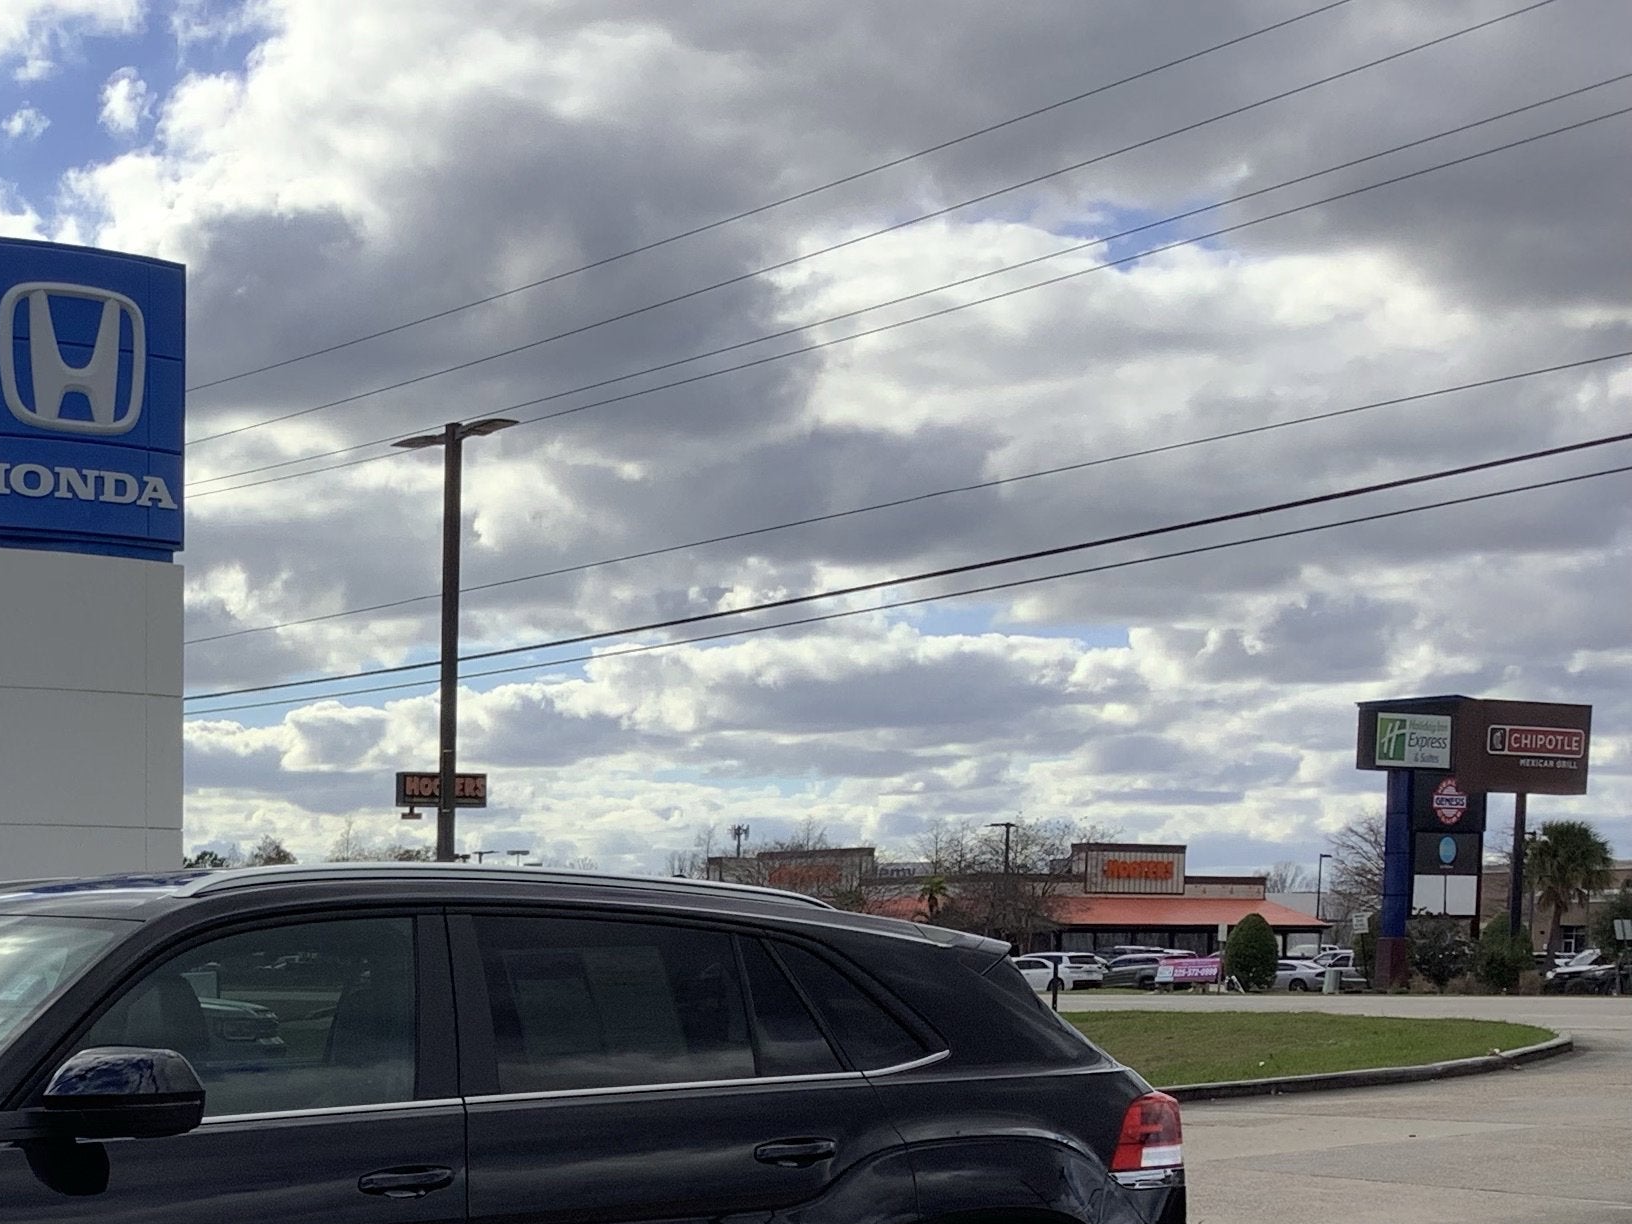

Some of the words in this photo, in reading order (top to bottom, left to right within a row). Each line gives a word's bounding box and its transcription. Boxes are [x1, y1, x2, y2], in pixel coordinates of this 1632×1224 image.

[1409, 732, 1447, 751] Express
[1511, 733, 1580, 751] CHIPOTLE
[1520, 759, 1554, 768] MEXICAN
[1556, 760, 1577, 769] GRILL
[405, 776, 485, 797] HOERS
[1435, 797, 1465, 806] GENESIS
